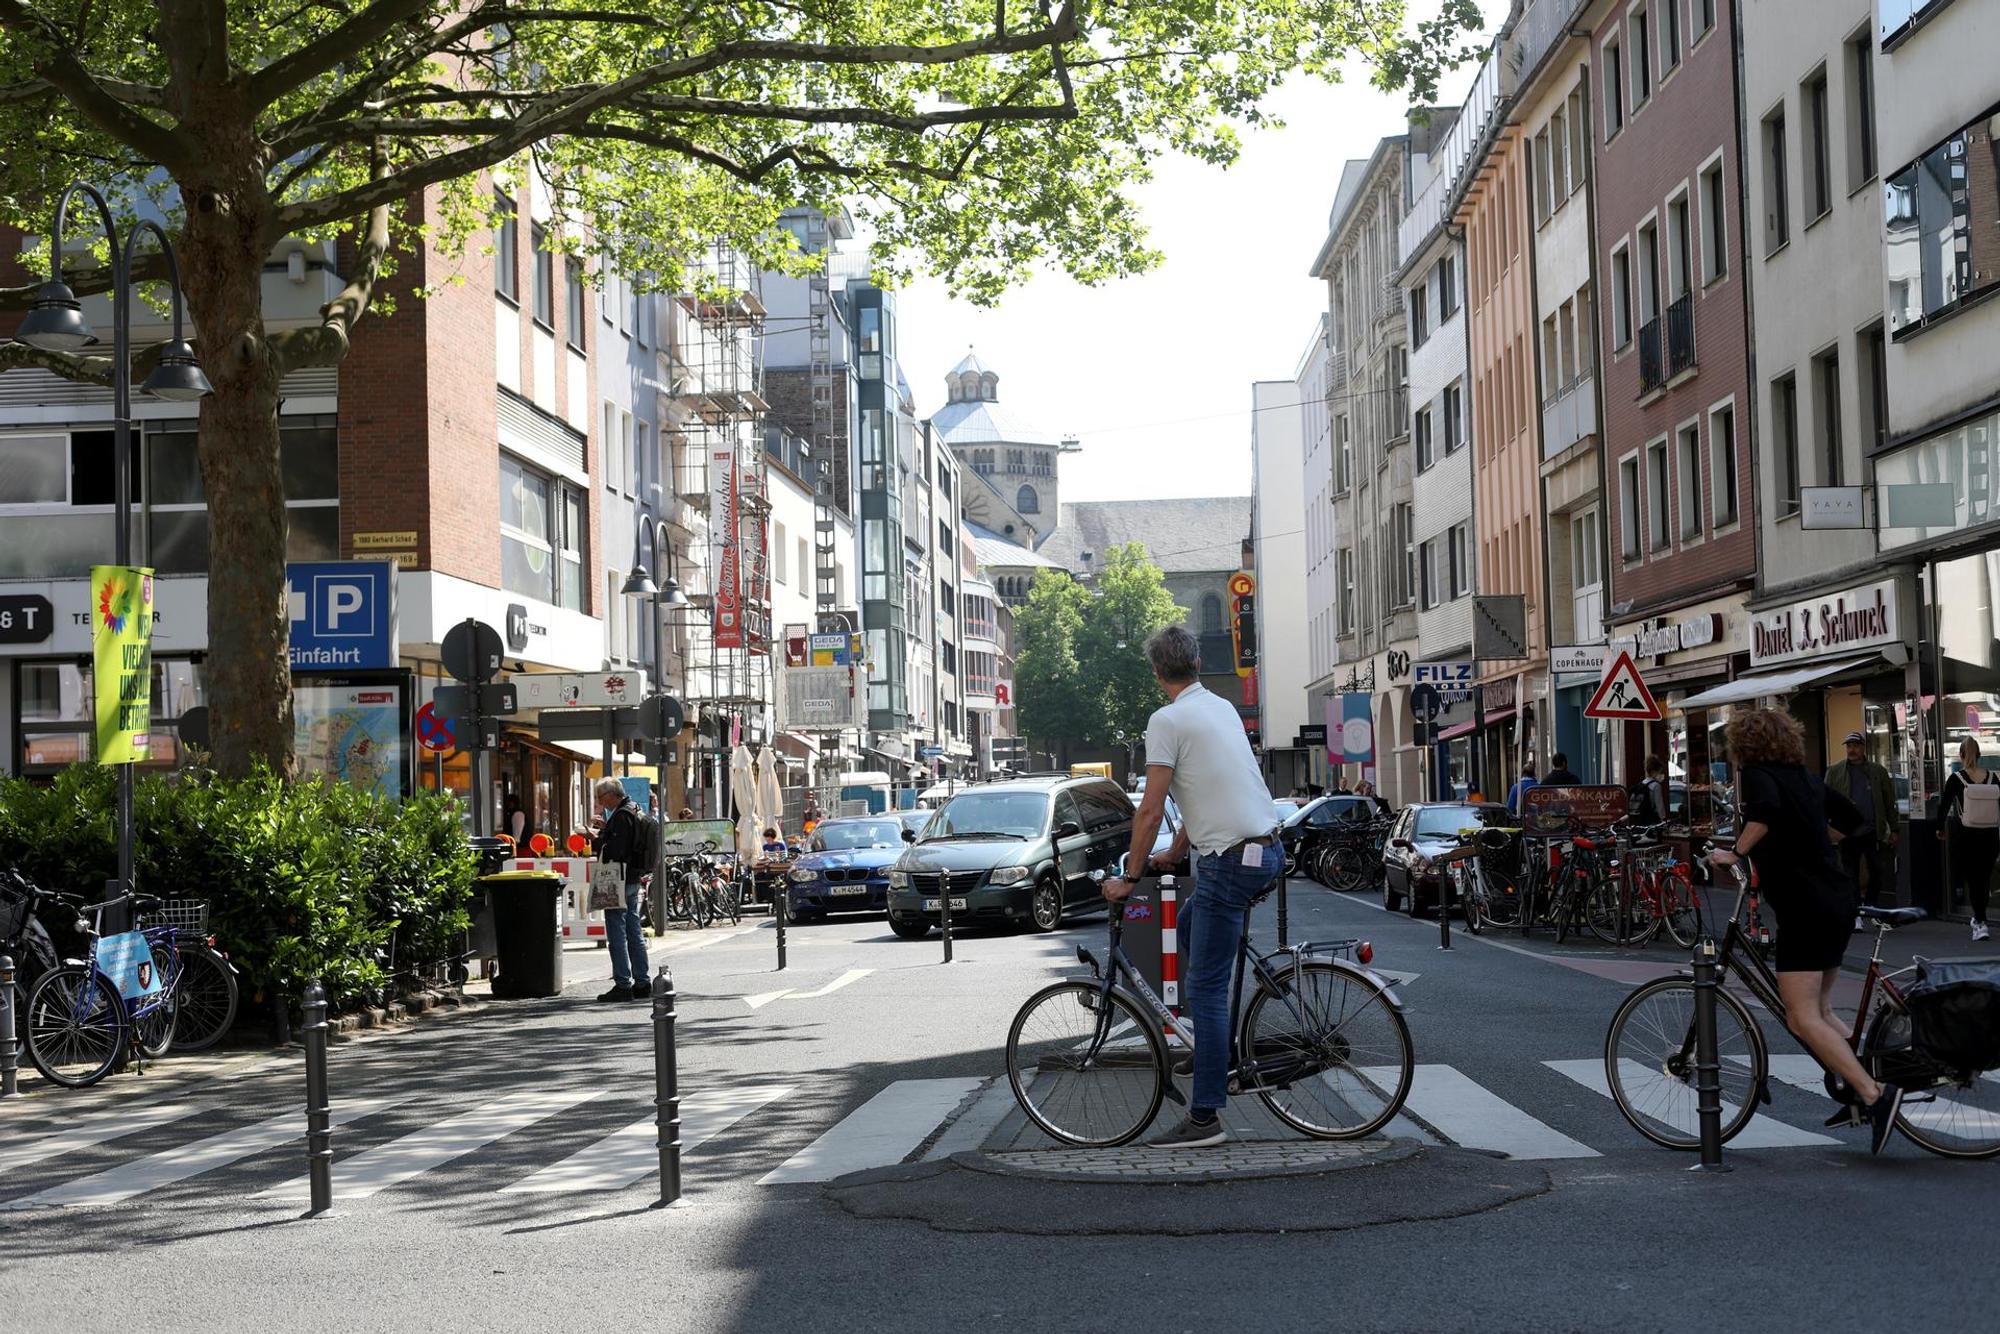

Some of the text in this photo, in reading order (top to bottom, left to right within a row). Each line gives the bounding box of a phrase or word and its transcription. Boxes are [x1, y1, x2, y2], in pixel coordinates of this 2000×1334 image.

[328, 585, 363, 629] P
[22, 607, 39, 630] T
[289, 647, 361, 664] Einfahrt
[1416, 665, 1471, 681] FILZ
[1531, 791, 1621, 802] GOLDANKAUF
